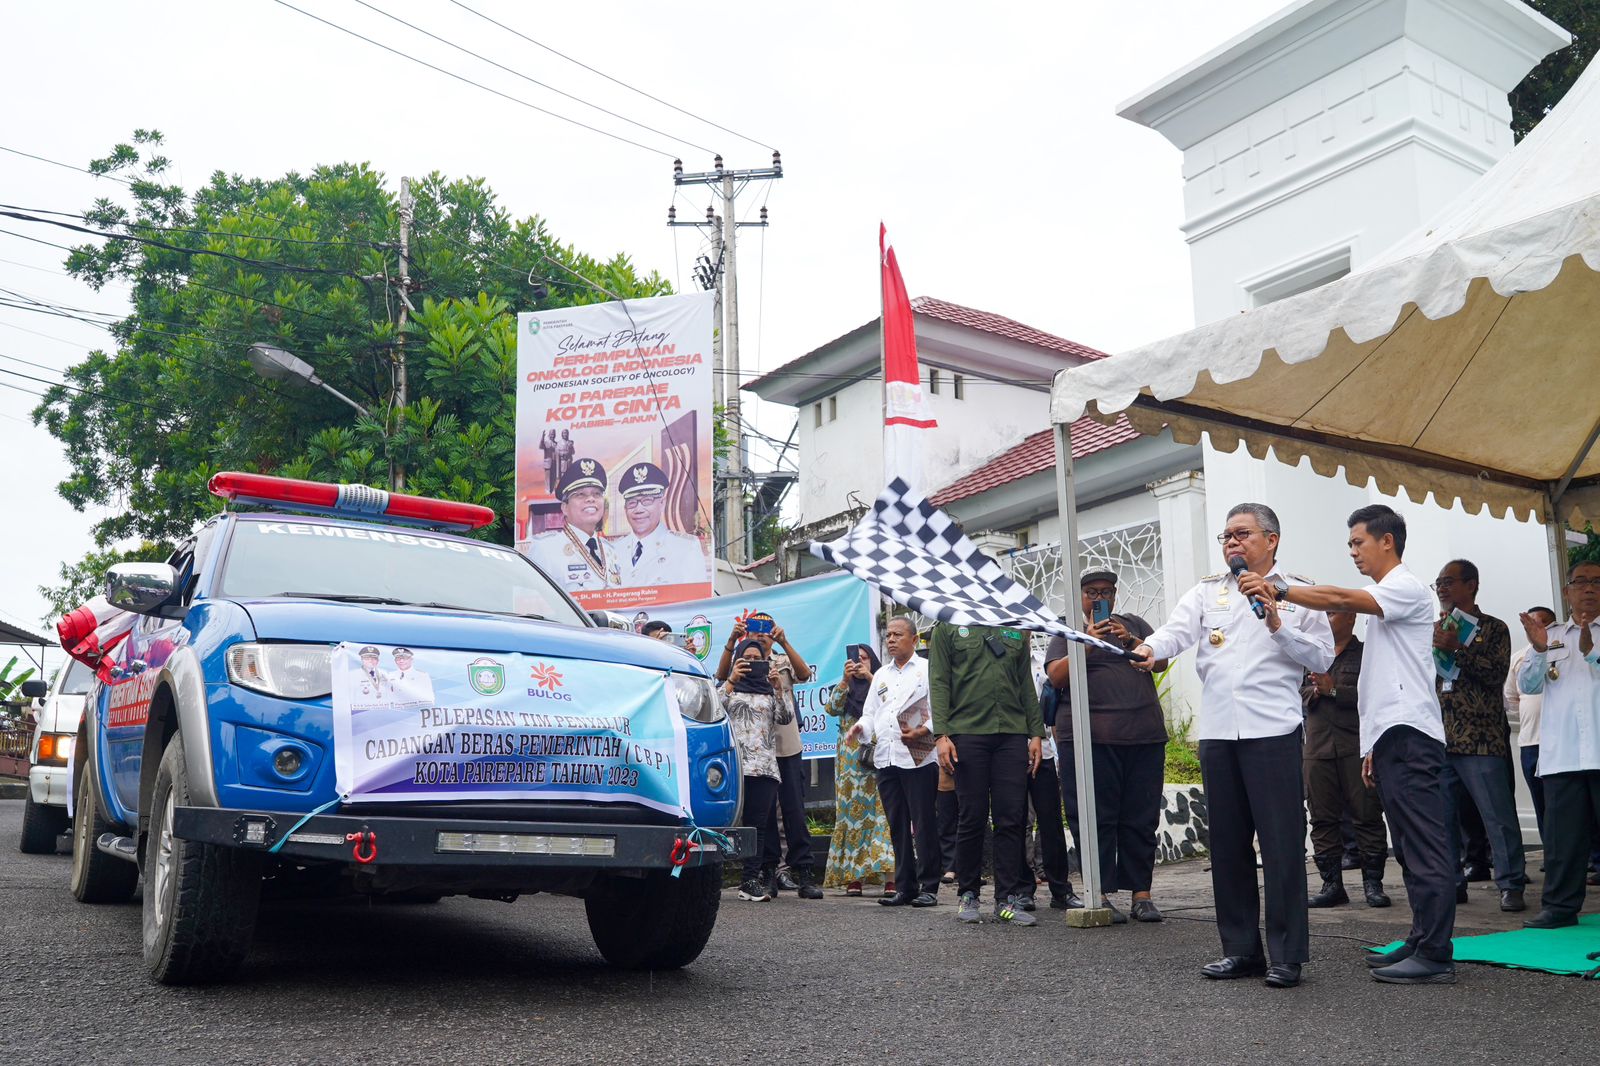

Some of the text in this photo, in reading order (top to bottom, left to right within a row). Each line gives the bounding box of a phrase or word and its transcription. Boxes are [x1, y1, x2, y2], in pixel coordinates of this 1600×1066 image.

[556, 327, 671, 356] Selamat Datang
[526, 353, 703, 383] ONKOLOGI INDONESIA
[553, 343, 676, 368] PERHIMPUNAN
[533, 367, 695, 392] (INDONESIAN SOCIETY OF ONCOLOGY)
[559, 383, 669, 405] DI PAREPARE
[545, 395, 681, 423] KOTA CINTA
[257, 523, 513, 561] KEMENSOS RI
[527, 688, 572, 702] BULOG
[420, 707, 632, 737] PELEPASAN TIM PENYALUR
[799, 714, 826, 733] 023
[365, 732, 456, 761] CADANGAN
[460, 732, 515, 756] BERAS
[519, 734, 622, 758] PEMERINTAH
[814, 743, 836, 751] Febru
[413, 761, 640, 787] KOTA PAREPARE TAHUN 2023
